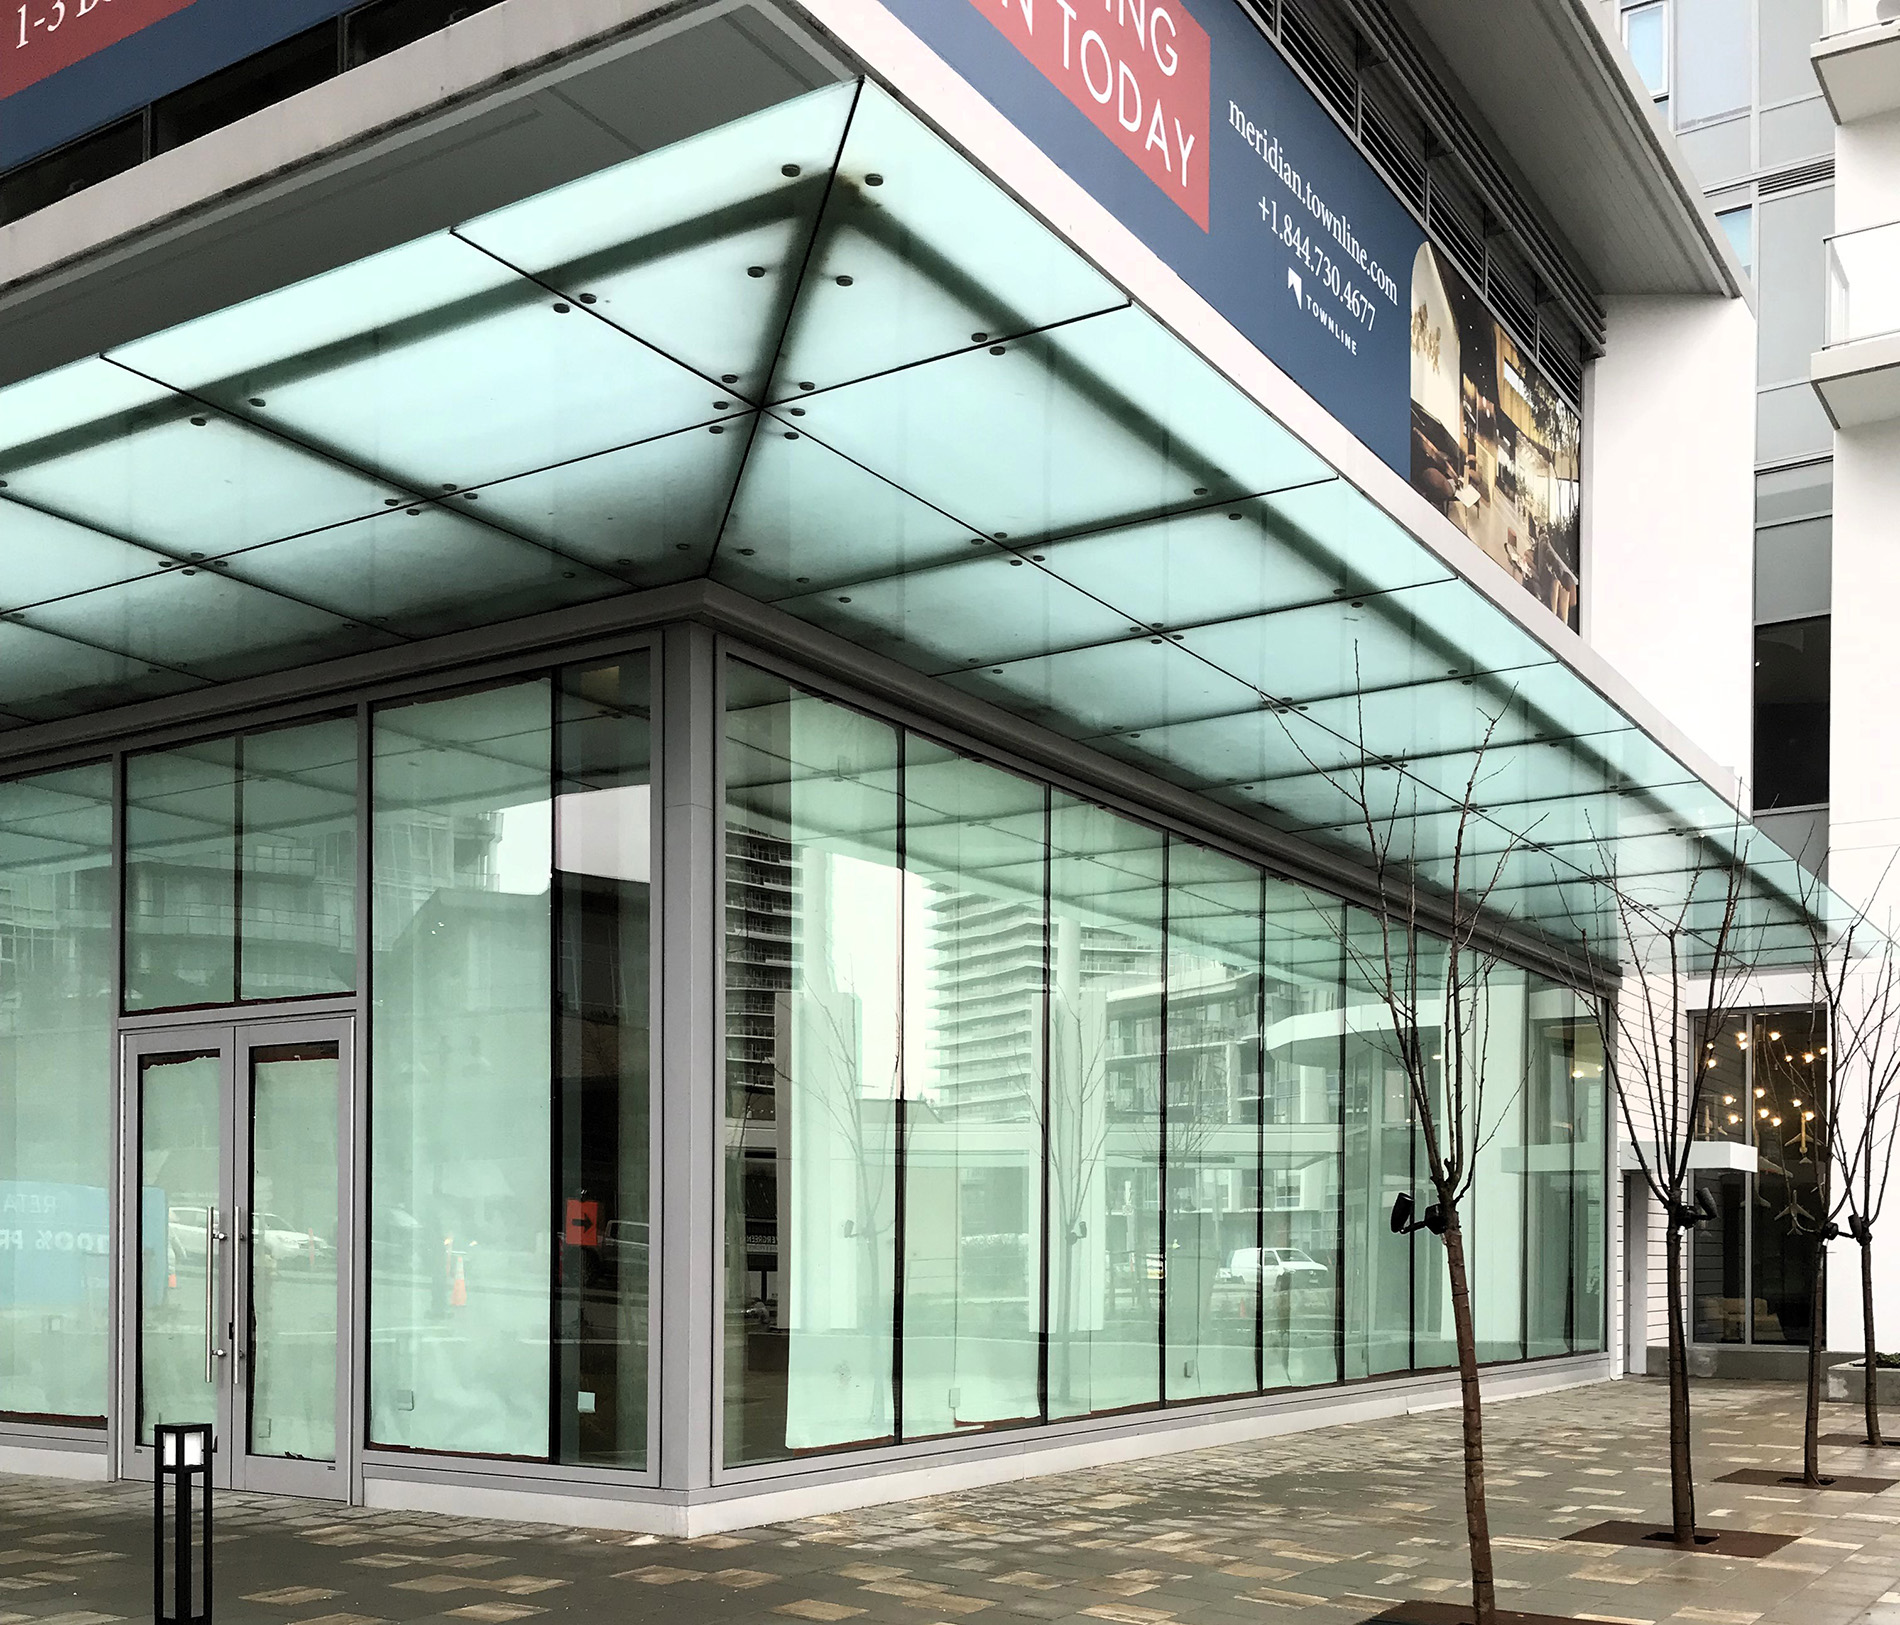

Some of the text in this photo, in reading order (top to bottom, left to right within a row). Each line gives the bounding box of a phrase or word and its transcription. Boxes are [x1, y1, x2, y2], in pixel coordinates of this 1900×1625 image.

[1055, 0, 1196, 188] TODAY
[1228, 100, 1399, 306] meridian.townline.com
[1258, 196, 1376, 331] +1.844.730.4677
[1306, 294, 1358, 355] TOWNLINE
